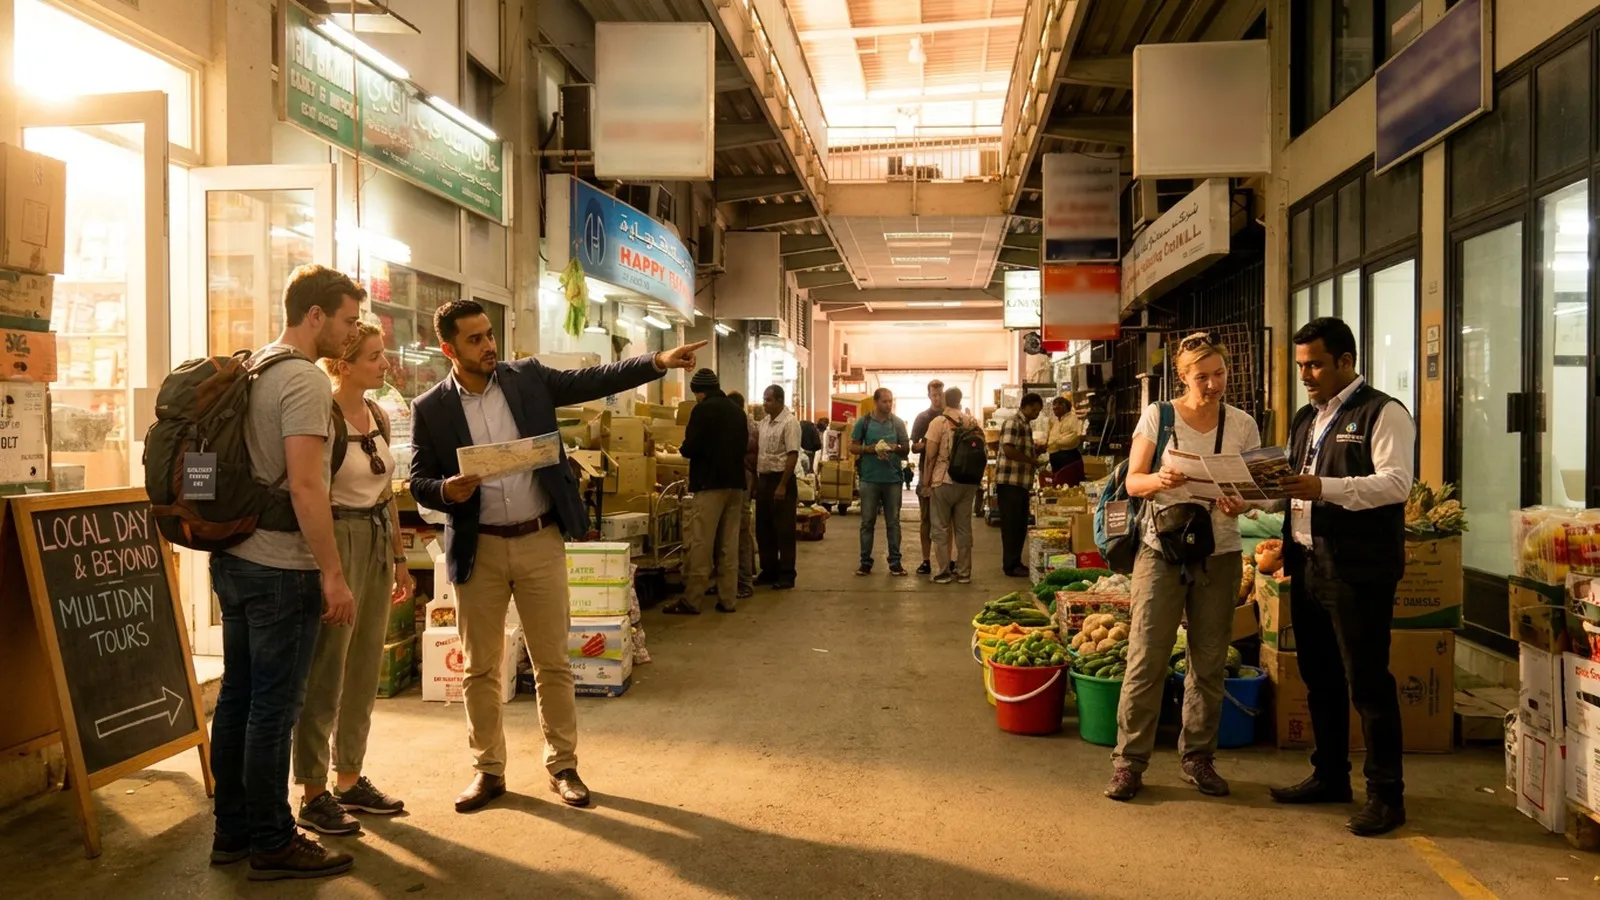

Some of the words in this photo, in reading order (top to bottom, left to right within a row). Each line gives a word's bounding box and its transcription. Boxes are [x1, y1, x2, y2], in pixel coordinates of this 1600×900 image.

[619, 244, 666, 282] HAPPY
[37, 512, 110, 552] LOCAL
[75, 555, 88, 580] &
[91, 545, 159, 577] BEYOND
[58, 585, 156, 630] MULTIDAY
[89, 622, 150, 657] TOURS
